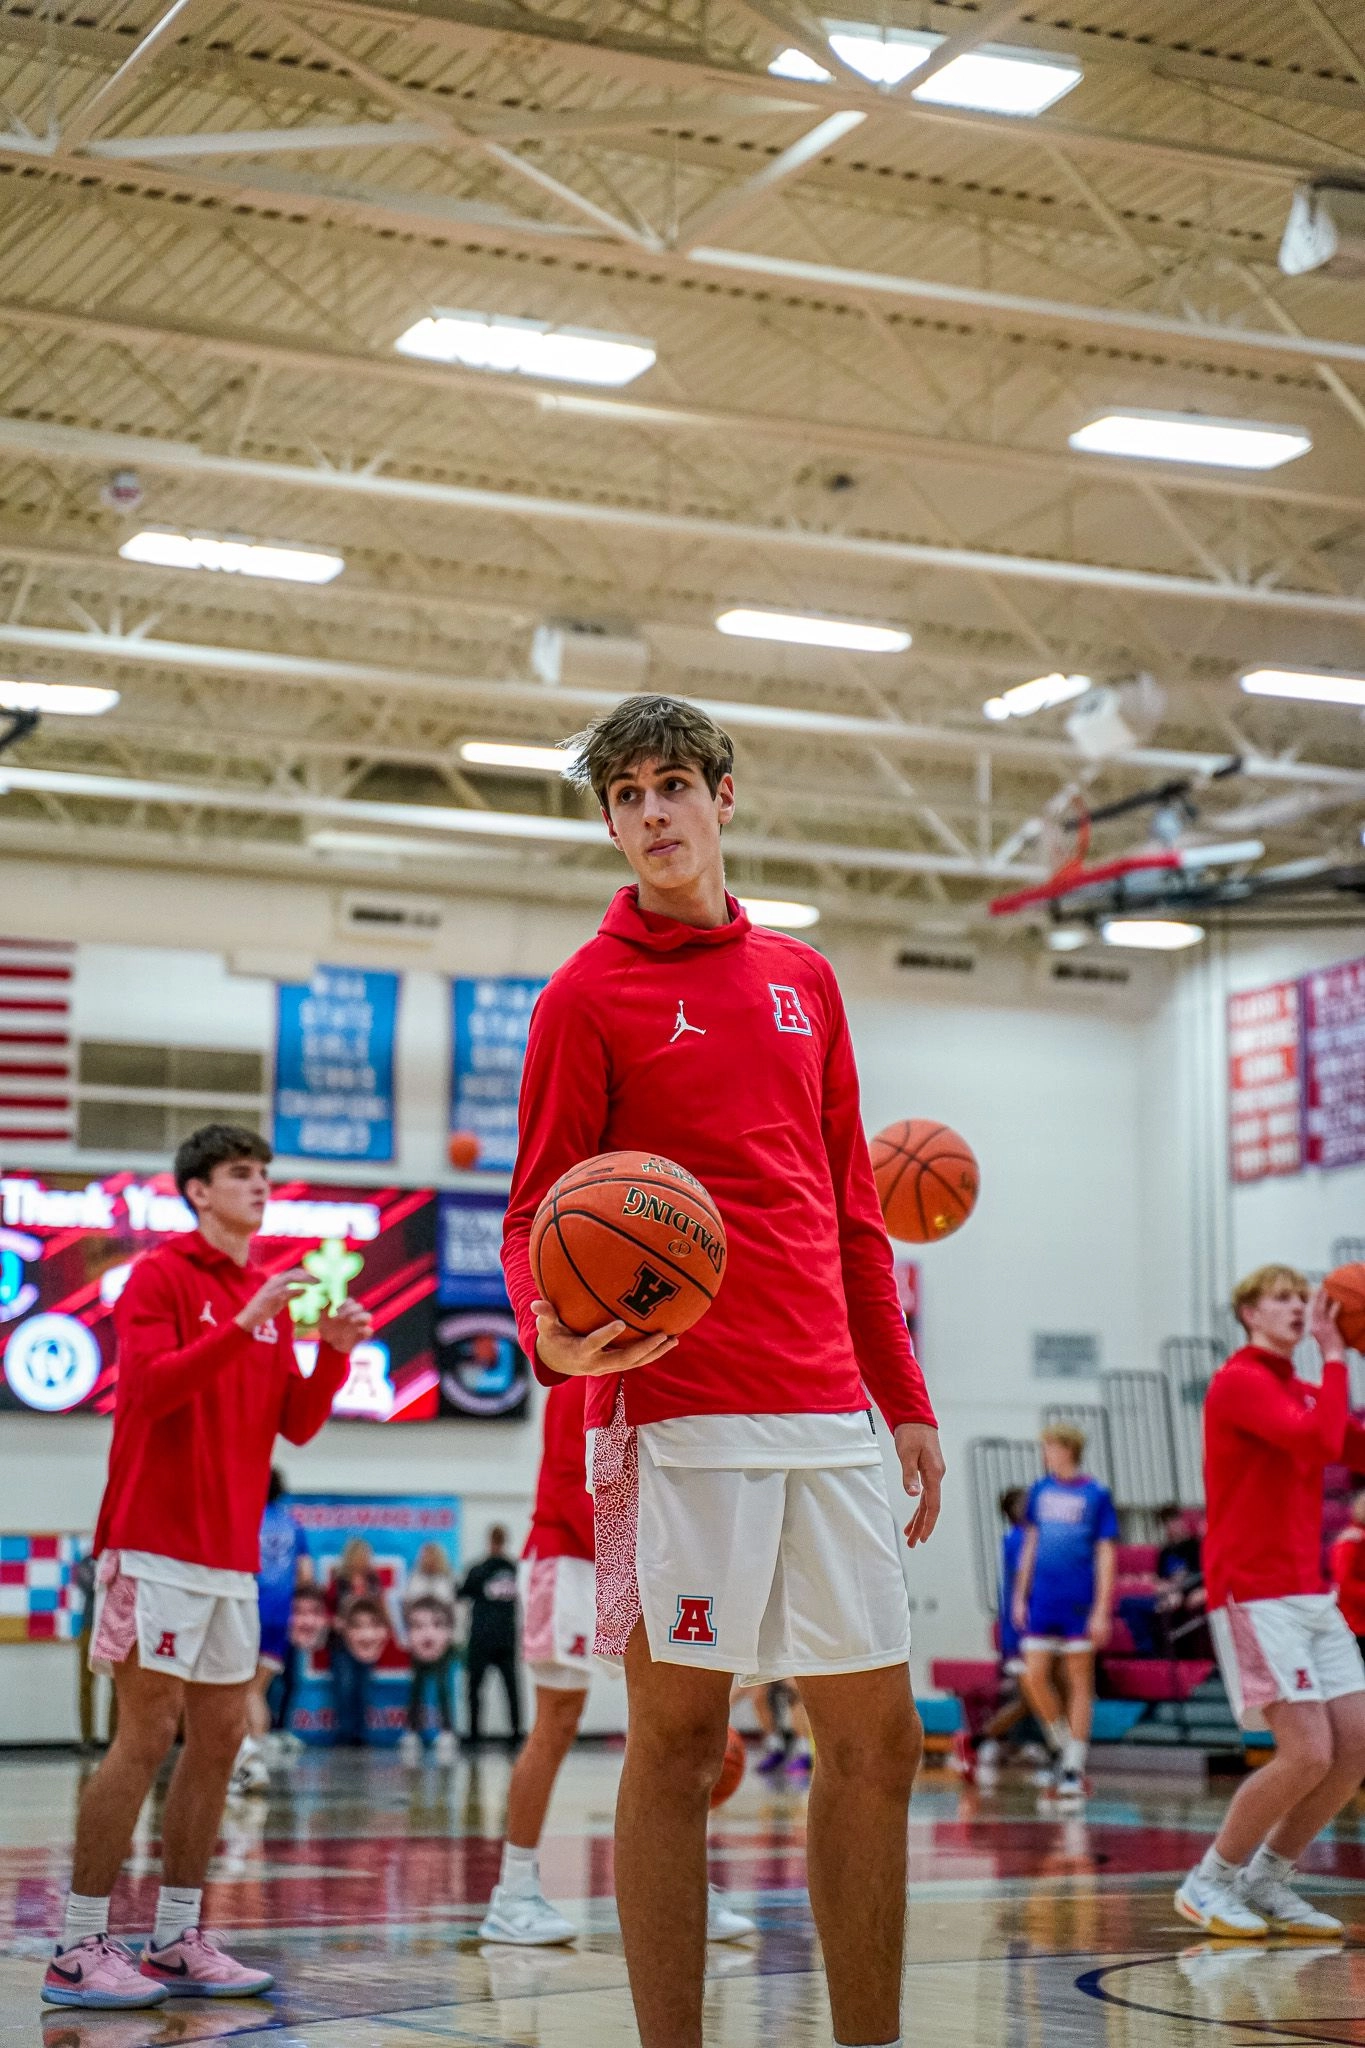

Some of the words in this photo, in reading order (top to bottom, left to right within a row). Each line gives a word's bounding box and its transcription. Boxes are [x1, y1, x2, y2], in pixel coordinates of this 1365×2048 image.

[768, 983, 812, 1036] A
[1, 1179, 114, 1228] Thank
[623, 1187, 726, 1274] SPALDING
[617, 1261, 682, 1320] A
[155, 1631, 176, 1659] A
[567, 1634, 586, 1658] A
[669, 1594, 717, 1646] A
